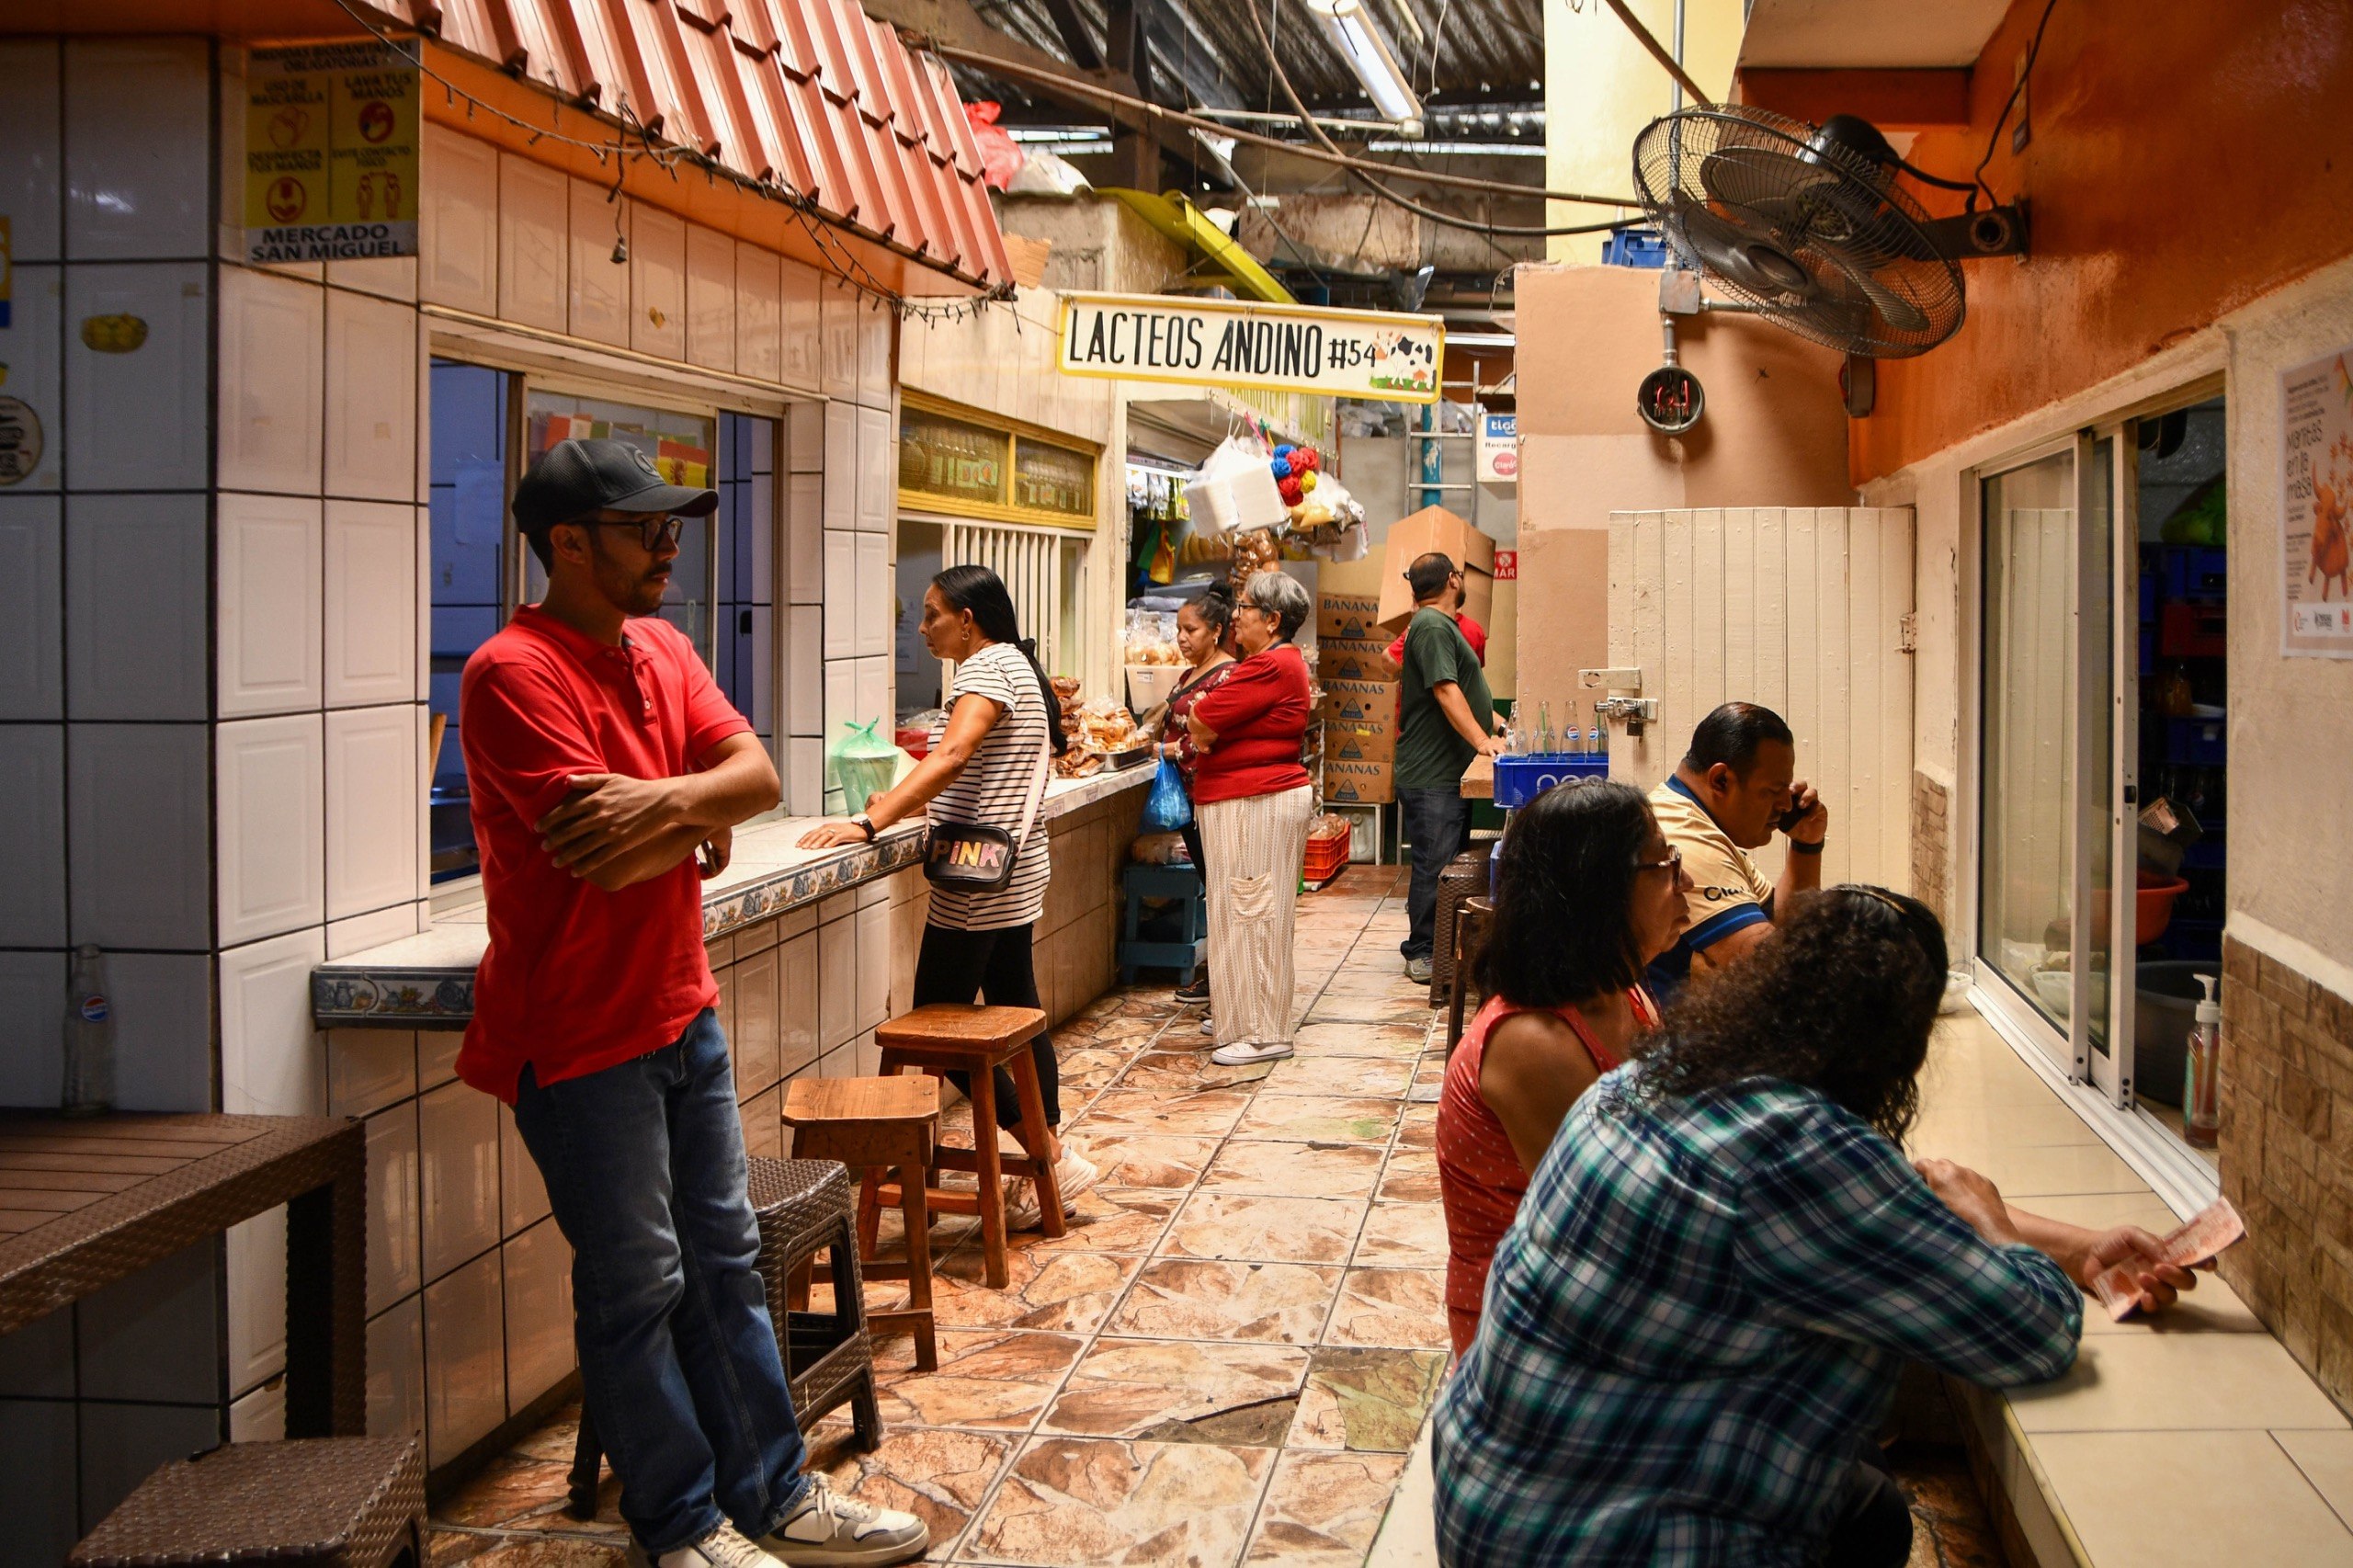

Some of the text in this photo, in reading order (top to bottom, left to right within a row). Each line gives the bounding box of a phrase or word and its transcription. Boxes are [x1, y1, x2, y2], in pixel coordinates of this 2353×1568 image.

[344, 72, 412, 89] LAVA TUS
[350, 85, 405, 100] MANOS
[275, 158, 322, 172] MANOS
[262, 223, 390, 244] MERCADO
[250, 240, 405, 262] SAN MIGUEL
[1069, 308, 1377, 379] LACTEOS ANDINO #54
[1324, 598, 1379, 613] BANANA
[1321, 638, 1384, 653] BANANAS
[1323, 680, 1385, 695] BANANAS
[1324, 762, 1381, 777] ANANAS
[930, 839, 1003, 868] PINK
